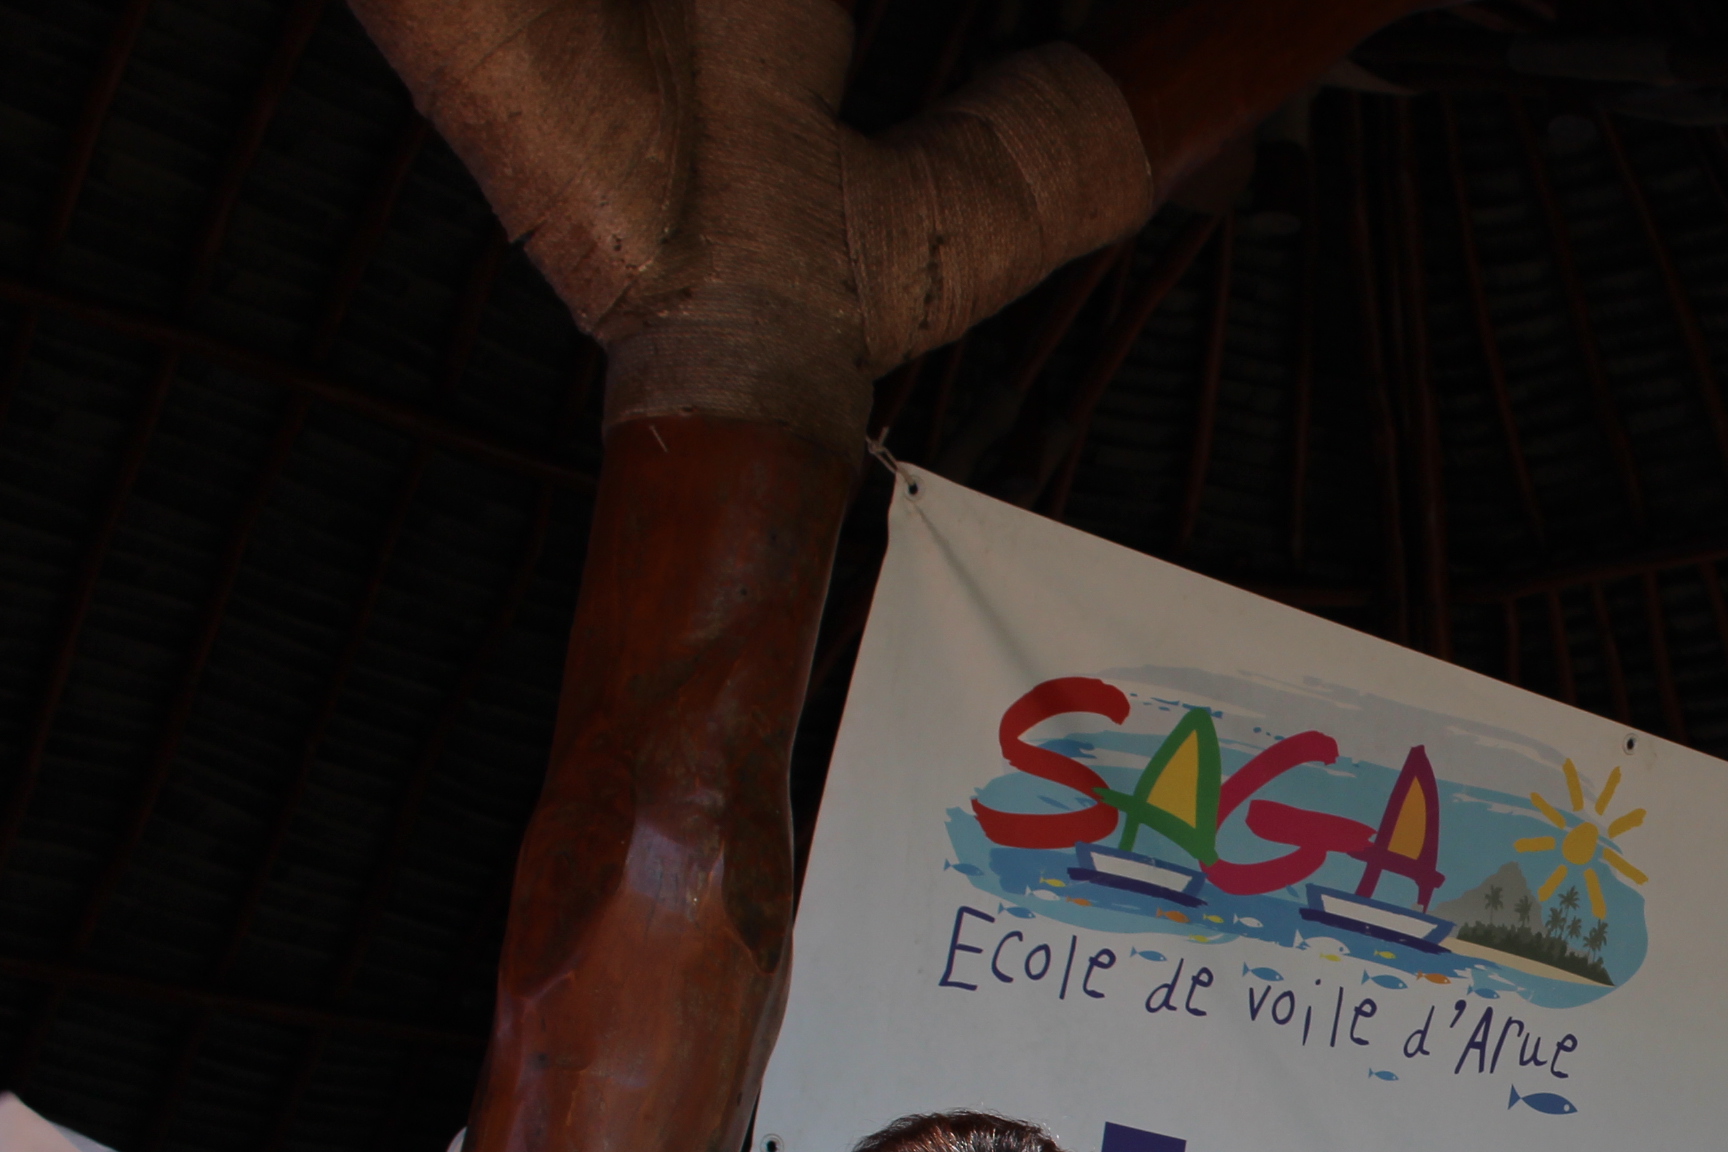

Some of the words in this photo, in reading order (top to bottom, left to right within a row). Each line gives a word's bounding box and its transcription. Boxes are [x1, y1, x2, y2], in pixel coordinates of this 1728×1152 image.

[971, 676, 1445, 914] SAGA
[939, 906, 1117, 1000] Ecole
[1145, 957, 1214, 1017] de
[1247, 978, 1378, 1049] voile
[1403, 999, 1578, 1079] d'Arue
